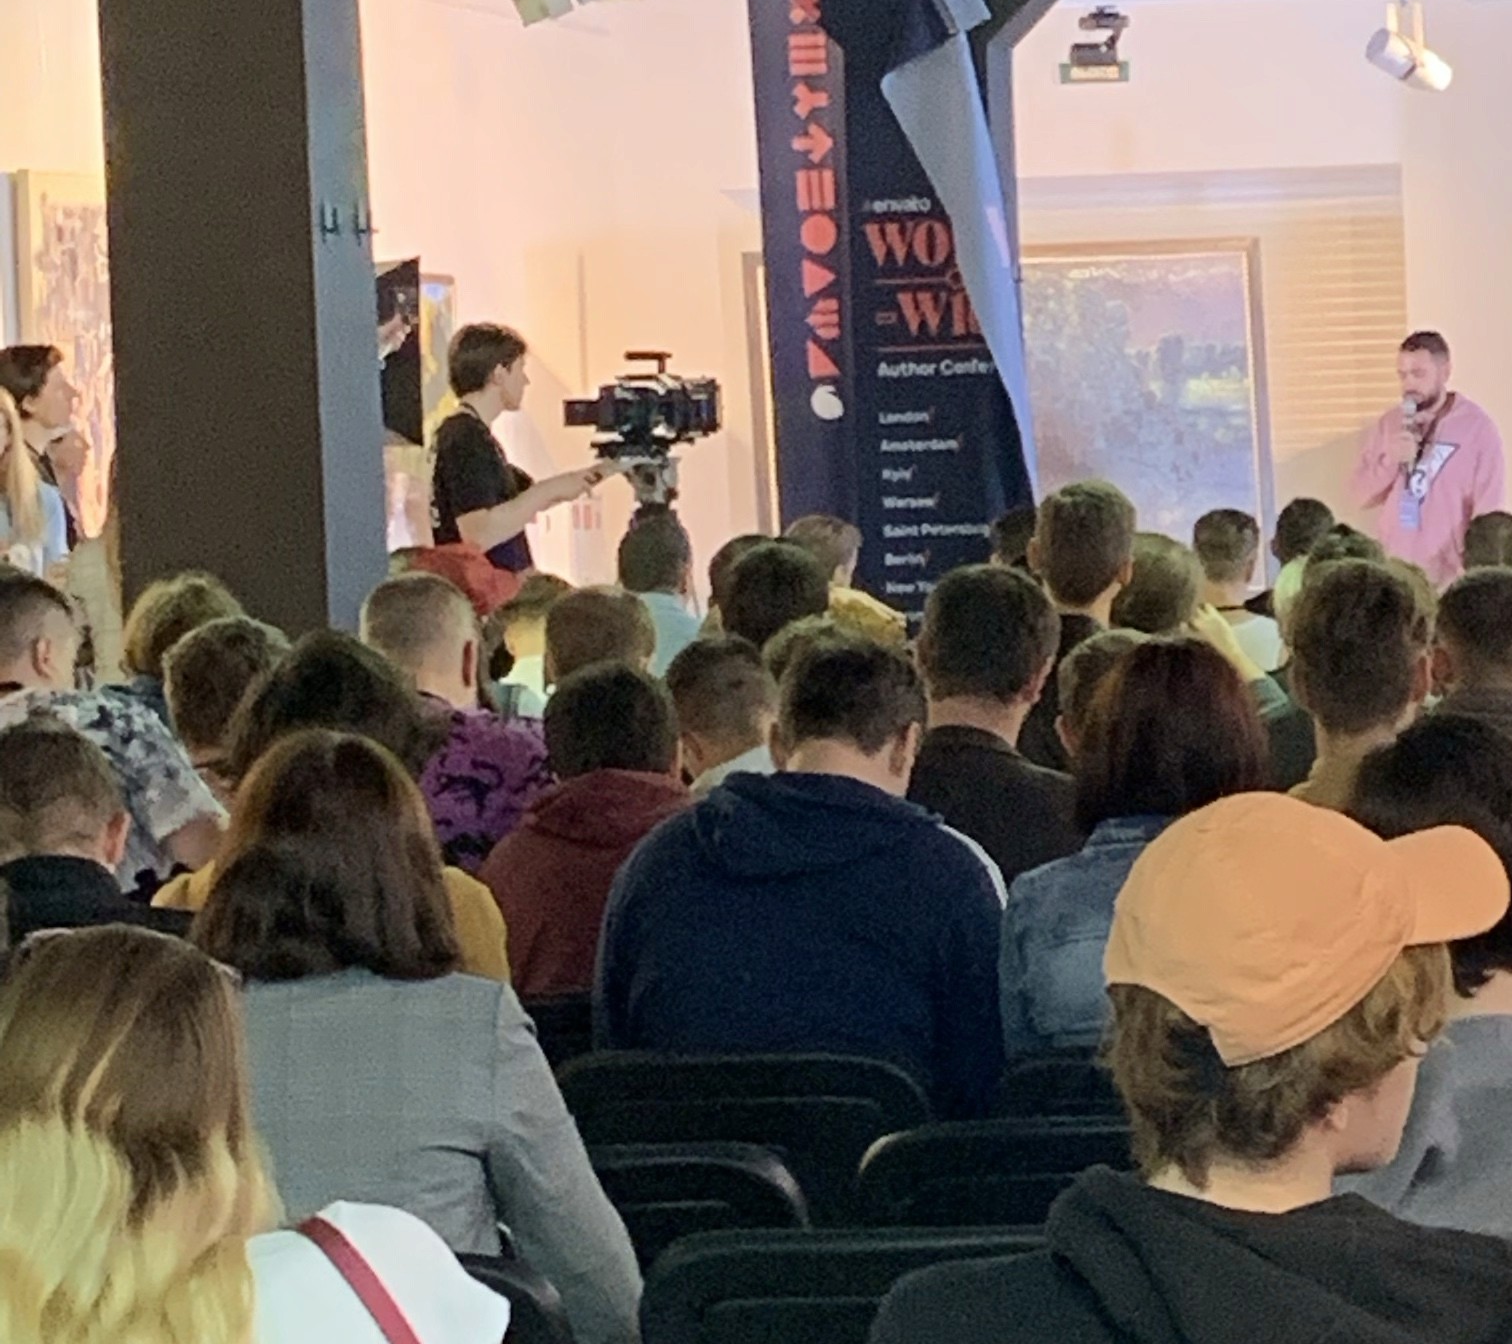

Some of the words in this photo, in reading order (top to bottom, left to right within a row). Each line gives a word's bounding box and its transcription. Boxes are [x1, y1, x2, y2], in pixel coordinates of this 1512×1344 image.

[878, 361, 937, 377] Author
[878, 411, 930, 425] London
[880, 439, 959, 452] Amsterdam
[882, 497, 936, 509] Warsaw
[882, 524, 919, 538] Saint
[885, 553, 925, 567] Berlin
[886, 582, 915, 594] New
